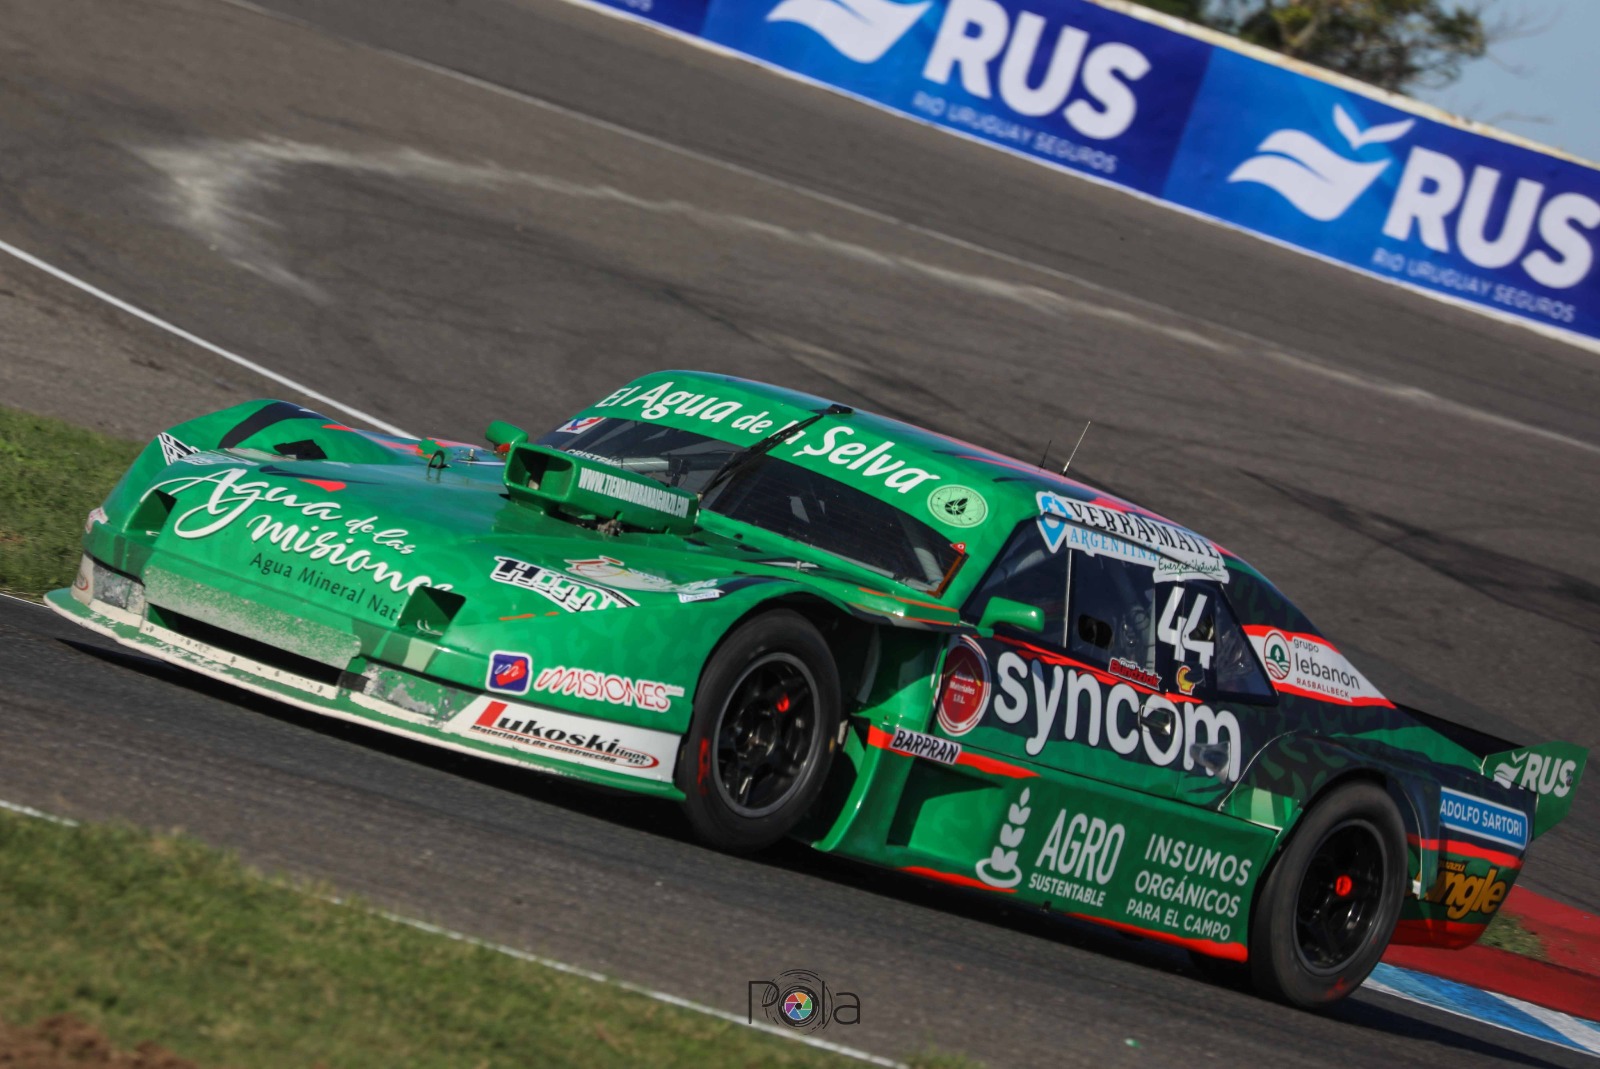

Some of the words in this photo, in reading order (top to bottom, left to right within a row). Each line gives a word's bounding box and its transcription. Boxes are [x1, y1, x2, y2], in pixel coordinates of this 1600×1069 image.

[921, 0, 1152, 140] RUS
[947, 105, 1034, 145] URUGUAY
[1034, 131, 1118, 174] SEGUROS
[1382, 145, 1600, 289] RUS
[1406, 258, 1491, 296] URUGUAY
[1493, 283, 1577, 323] SEGUROS
[631, 381, 743, 420] Agua
[731, 410, 773, 434] de
[792, 425, 942, 494] Selva
[140, 467, 343, 538] Agua
[373, 528, 416, 555] las
[1154, 523, 1220, 559] MATE
[250, 552, 293, 577] Agua
[297, 567, 366, 605] Mineral
[1157, 585, 1215, 670] 44
[1293, 638, 1319, 653] grupo
[536, 668, 670, 710] MISIONES
[1295, 652, 1360, 690] lebanon
[1296, 677, 1349, 699] RASBALLBECK
[470, 724, 531, 745] Materiales
[532, 739, 546, 749] de
[994, 652, 1241, 783] syncom
[892, 730, 959, 763] BARPRAN
[1519, 752, 1577, 798] RUS
[1440, 798, 1480, 825] ADOLFO
[1482, 809, 1522, 838] SARTORI
[1035, 808, 1126, 885] AGRO
[1145, 833, 1252, 887] INSUMOS
[1028, 872, 1107, 907] SUSTENTABLE
[1135, 873, 1241, 918] ORGÁNICOS
[1126, 898, 1161, 923] PARA
[1163, 909, 1180, 928] EL
[1183, 917, 1231, 941] CAMPO
